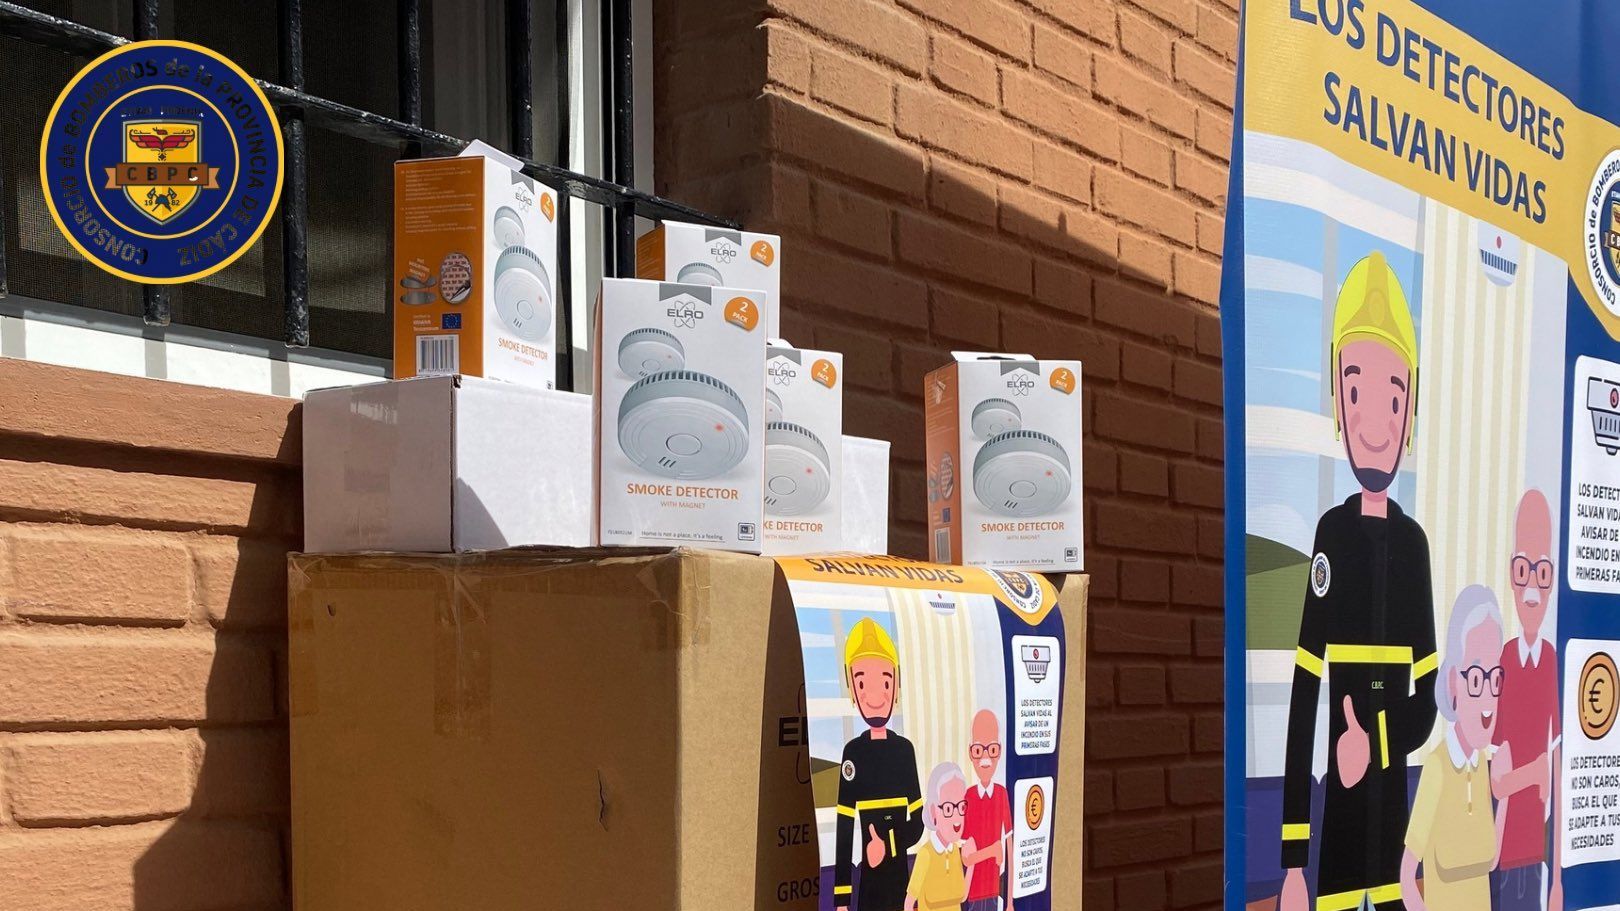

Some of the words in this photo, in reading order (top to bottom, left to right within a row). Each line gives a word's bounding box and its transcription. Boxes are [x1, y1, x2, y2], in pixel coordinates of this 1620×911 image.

[1290, 0, 1366, 50] LOS
[1376, 12, 1565, 160] DETECTORES
[1324, 71, 1456, 182] SALVAN
[1463, 141, 1547, 224] VIDAS
[515, 192, 532, 206] ELRO
[1588, 210, 1597, 228] de
[710, 248, 736, 257] ELRO
[760, 244, 766, 252] 2
[1588, 233, 1616, 306] CONSORCIO
[667, 308, 704, 320] ELRO
[740, 302, 748, 312] 2
[732, 312, 748, 323] PACK
[498, 337, 520, 352] SMOKE
[521, 344, 548, 360] DETECTOR
[768, 368, 796, 378] ELRO
[822, 363, 829, 372] 2
[817, 372, 829, 382] PACK
[1060, 371, 1068, 380] 2
[1006, 380, 1034, 388] ELRO
[1056, 379, 1068, 388] PACK
[627, 483, 672, 496] SMOKE
[676, 486, 738, 500] DETECTOR
[1578, 482, 1592, 498] LOS
[1578, 504, 1604, 520] SALVAN
[776, 522, 823, 532] DETECTOR
[981, 522, 1015, 532] SMOKE
[1018, 522, 1065, 532] DETECTOR
[1581, 526, 1608, 540] AVISAR
[1610, 528, 1619, 542] DE
[1576, 546, 1610, 560] INCENDIO
[805, 558, 900, 579] SALVAN
[898, 565, 964, 584] VIDAS
[1576, 566, 1610, 582] PRIMERAS
[1571, 756, 1579, 770] LOS
[1572, 777, 1578, 790] NO
[1579, 776, 1592, 789] SON
[1572, 796, 1590, 810] BUSCA
[1592, 796, 1600, 808] EL
[1602, 794, 1618, 809] QUE
[1568, 818, 1574, 831] SE
[1574, 815, 1599, 829] ADAPTE
[1600, 814, 1606, 826] A
[1608, 814, 1620, 826] TUS
[778, 824, 810, 847] SIZE
[1571, 834, 1614, 850] NECESIDADES
